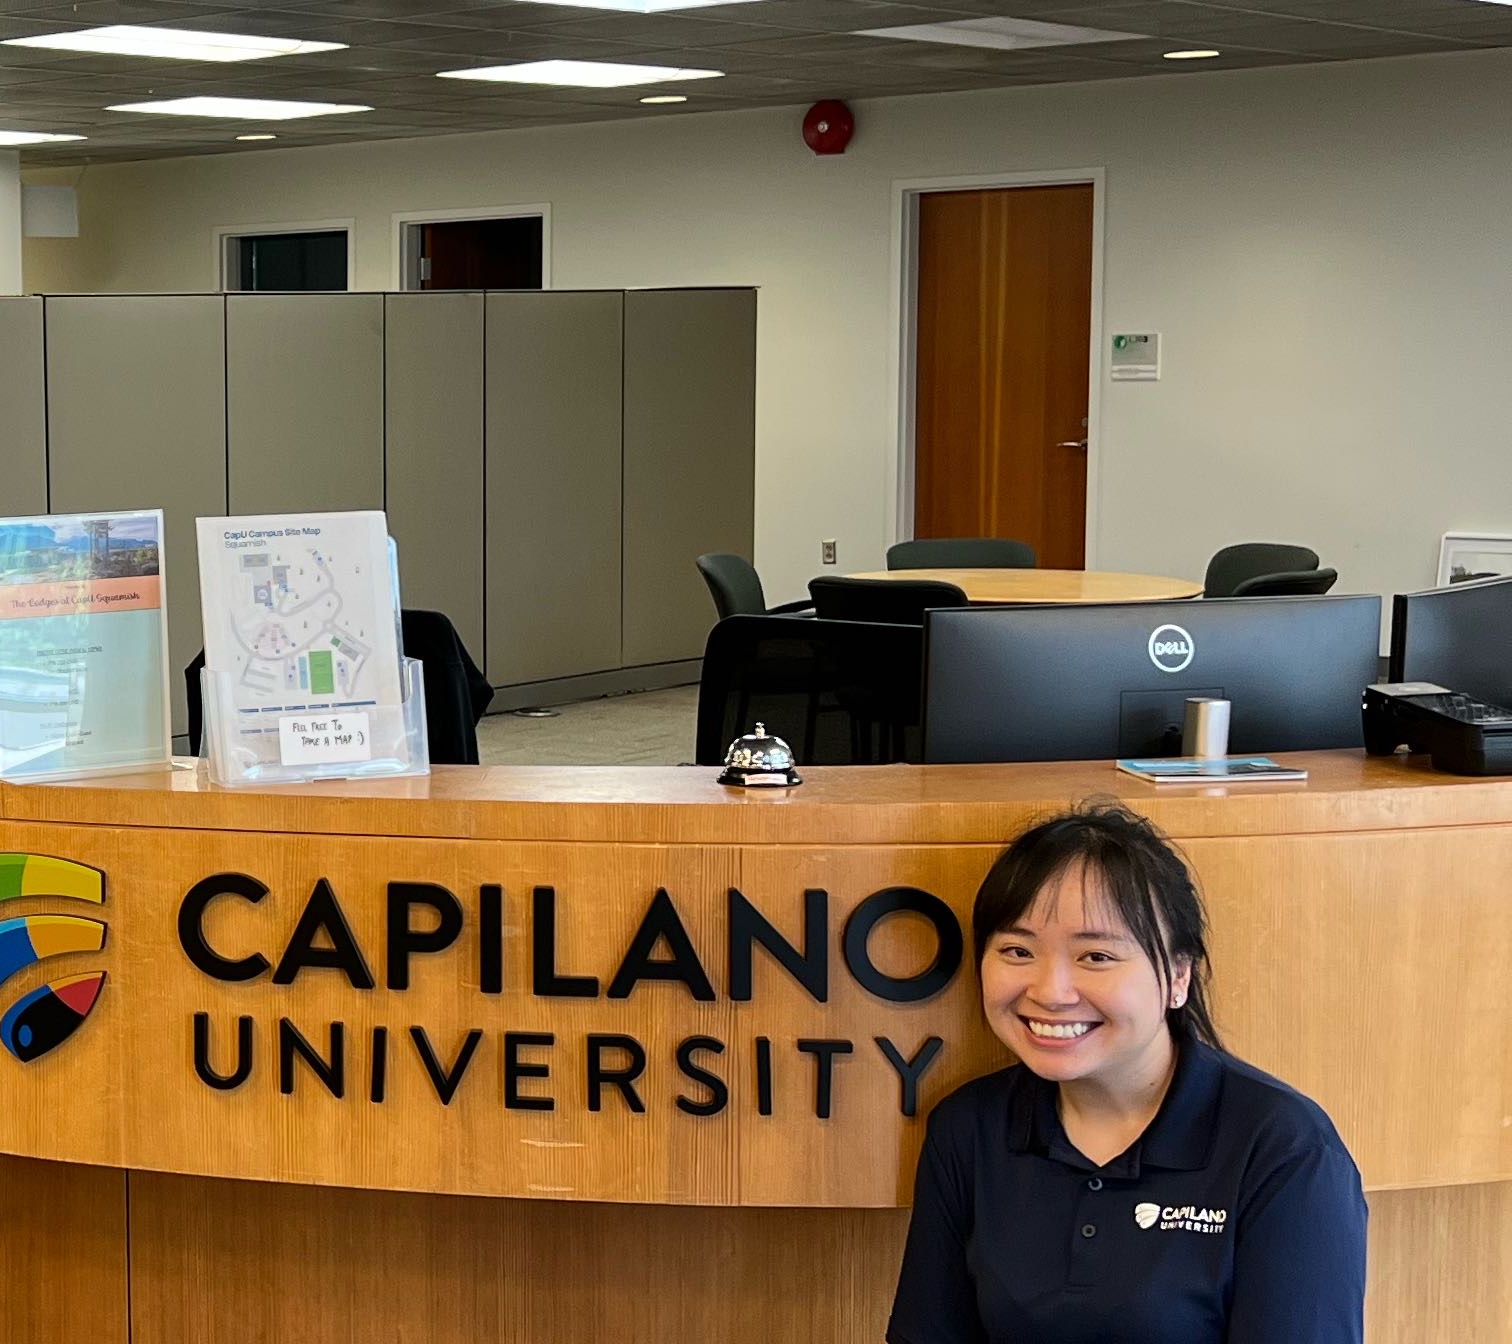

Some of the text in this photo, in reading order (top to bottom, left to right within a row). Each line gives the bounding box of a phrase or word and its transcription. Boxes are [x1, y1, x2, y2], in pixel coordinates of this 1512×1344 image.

[223, 527, 321, 540] CapU Campus Site Map
[224, 539, 267, 549] Squamish
[10, 599, 27, 609] The
[1154, 641, 1189, 656] DELL
[334, 734, 353, 746] MAP
[177, 871, 964, 1005] CAPILANO
[191, 1010, 945, 1119] UNIVERSITY
[1161, 1205, 1227, 1223] CAPILANO
